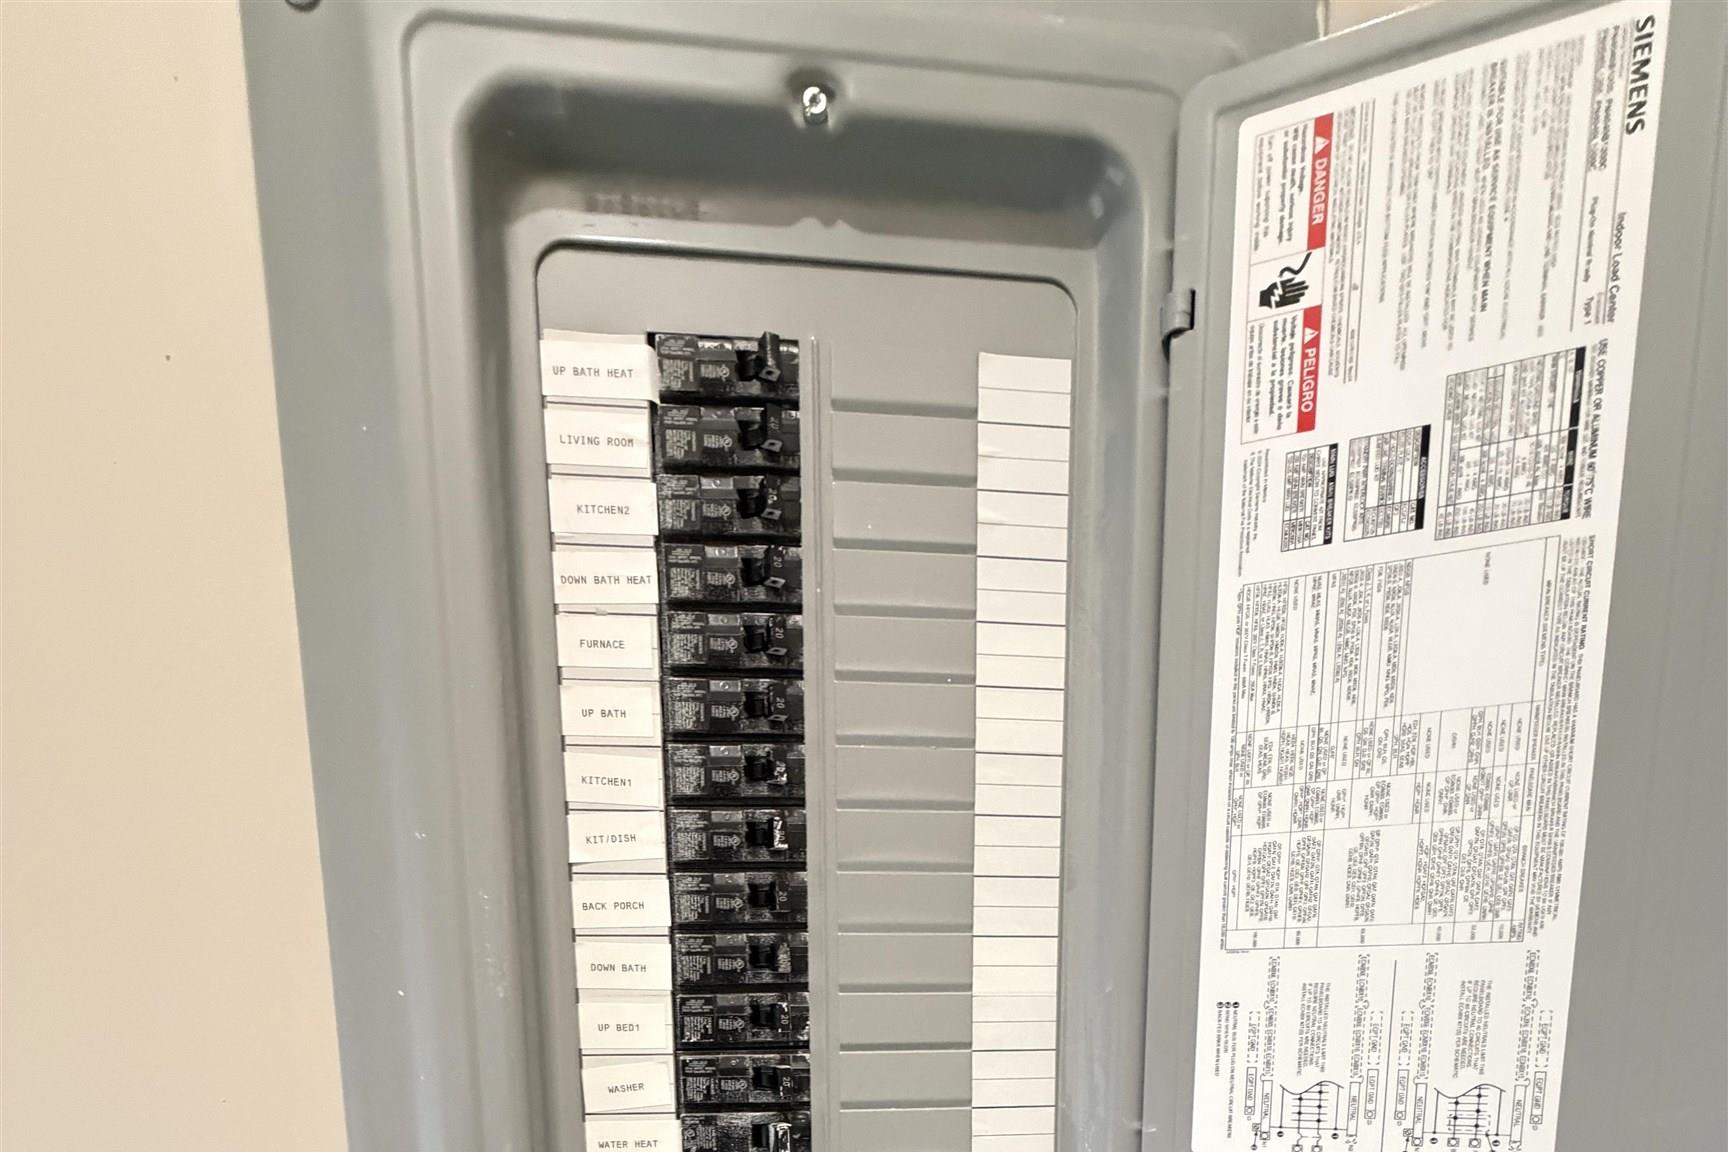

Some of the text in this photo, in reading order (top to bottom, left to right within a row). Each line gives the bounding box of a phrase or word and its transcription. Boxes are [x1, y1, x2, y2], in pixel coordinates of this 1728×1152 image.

[1625, 14, 1655, 135] SIEMENS
[1312, 157, 1327, 225] DANGER
[1606, 211, 1626, 323] Indoor Load Center
[1582, 296, 1594, 318] Type
[1597, 338, 1608, 356] USE
[552, 365, 634, 379] UP BATH HEAT
[1593, 358, 1606, 395] COPPER
[1300, 347, 1316, 413] PELIGRO
[1592, 397, 1602, 411] OR
[559, 434, 634, 448] LIVING ROOM
[1587, 413, 1601, 458] ALUMINUM
[576, 504, 630, 516] KITCHEN2
[1582, 496, 1593, 519] WIRE
[773, 556, 782, 568] 20
[560, 574, 652, 585] DOWN BATH HEAT
[775, 627, 784, 639] 20
[579, 638, 625, 650] FURNACE
[776, 697, 785, 709] 20
[581, 708, 627, 719] UP BATH
[580, 775, 632, 787] KITCHEN1
[585, 833, 637, 845] KIT/DISH
[778, 891, 787, 902] 20
[581, 901, 645, 911] BACK PORCH
[590, 963, 647, 973] DOWN BATH
[780, 1014, 789, 1025] 20
[597, 1023, 640, 1032] UP BED1
[607, 1082, 645, 1094] WASHER
[1533, 1077, 1543, 1109] EQPT GND
[1349, 1095, 1357, 1121] NEUTRAL
[1415, 1096, 1423, 1124] NEUTRAL
[1513, 1099, 1522, 1127] NEUTRAL
[597, 1139, 659, 1149] WATER HEAT
